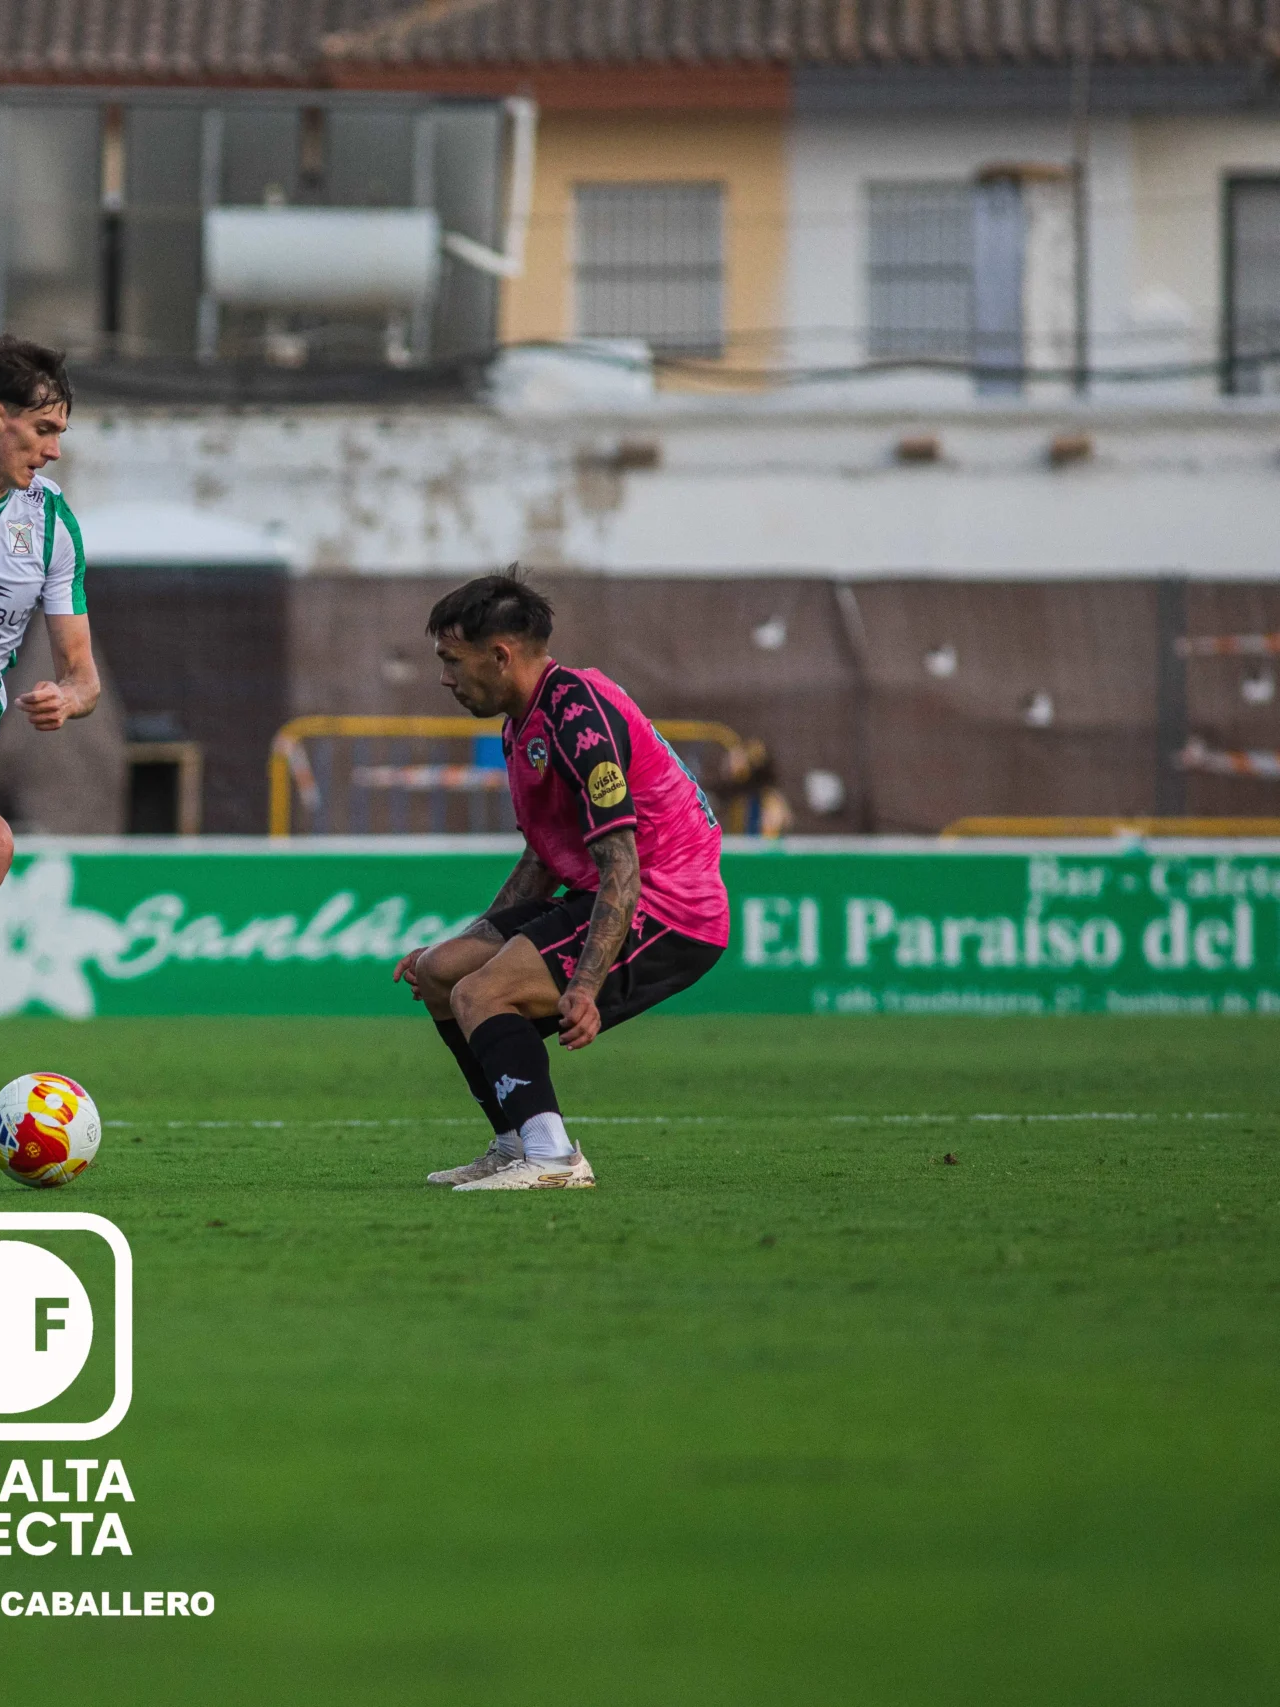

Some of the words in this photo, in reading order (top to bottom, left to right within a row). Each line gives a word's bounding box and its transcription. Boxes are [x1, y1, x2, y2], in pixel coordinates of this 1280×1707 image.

[593, 770, 619, 791] visit
[1029, 854, 1107, 898] Bar
[742, 897, 819, 968] El
[845, 896, 1122, 970] Paraíso
[1142, 899, 1254, 970] del
